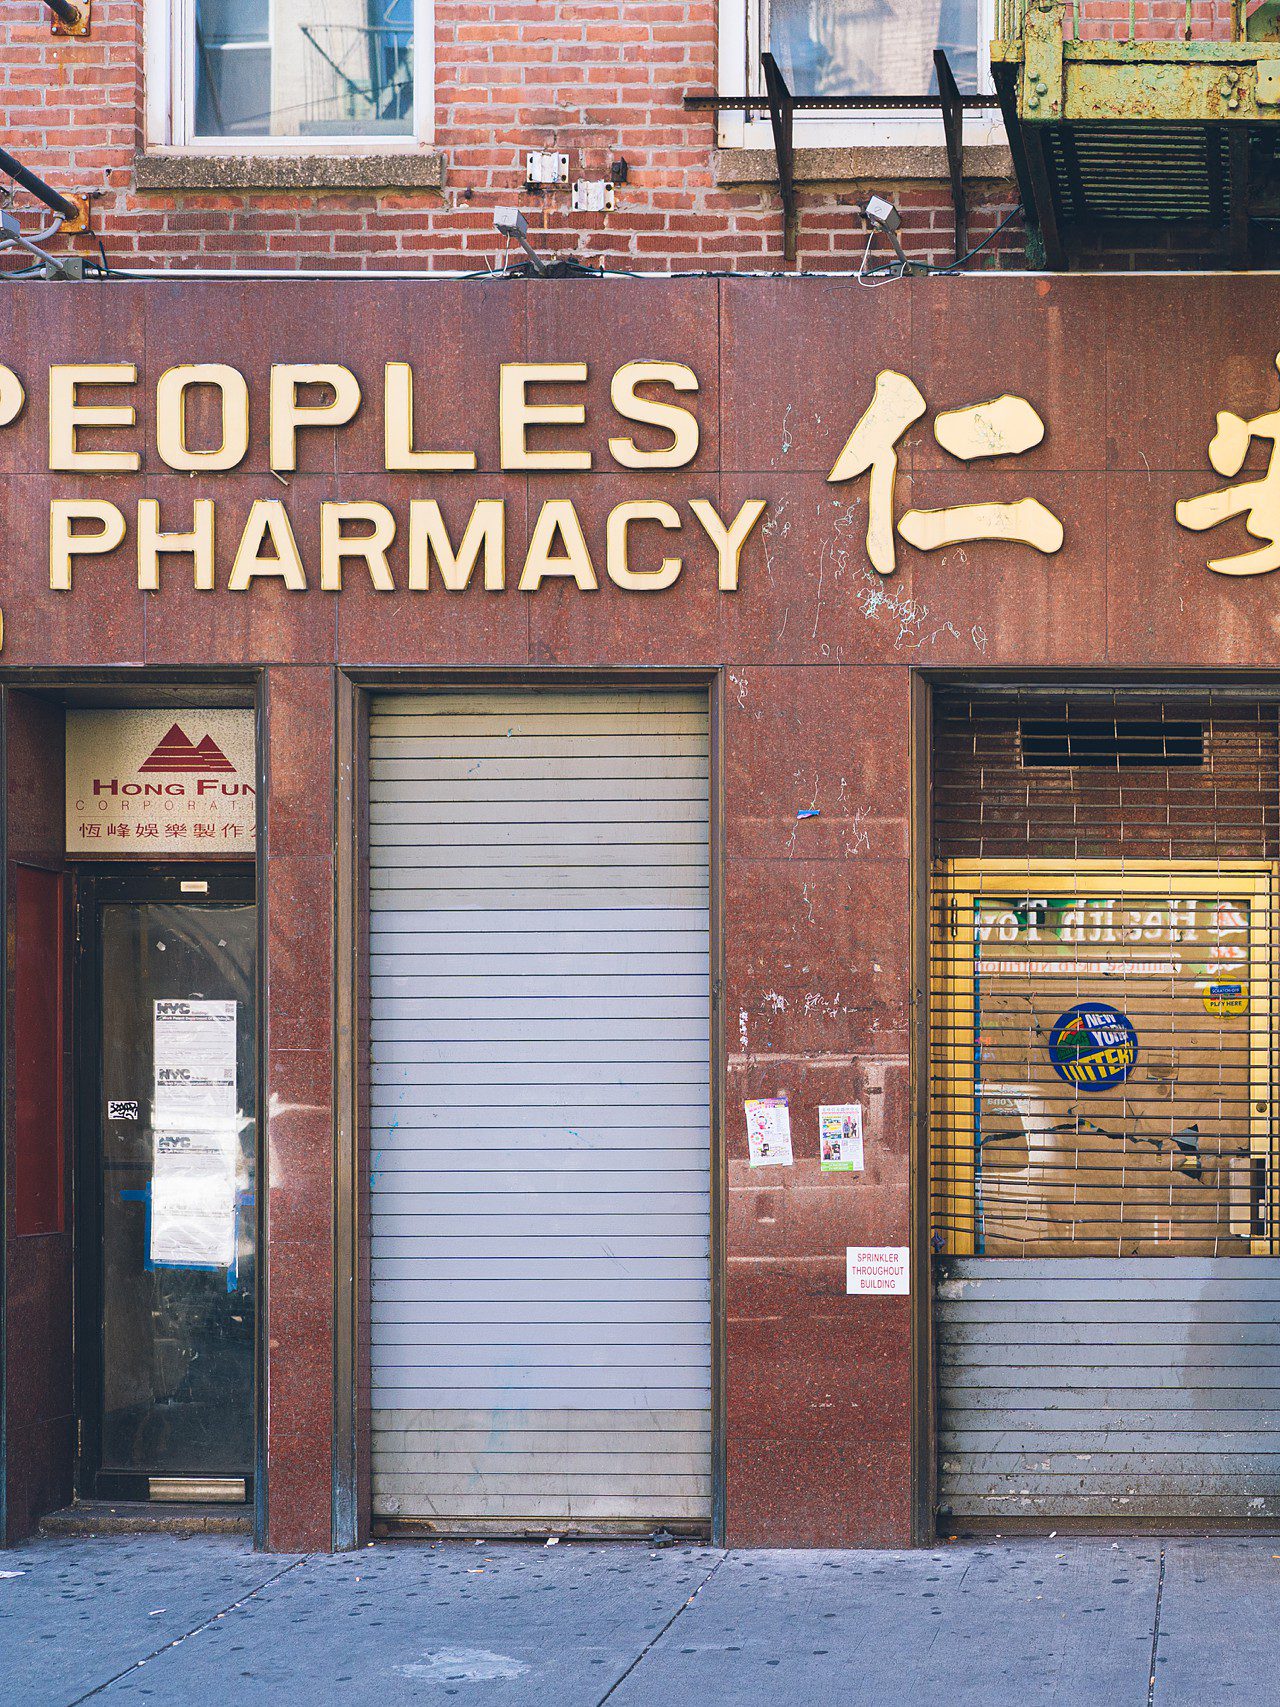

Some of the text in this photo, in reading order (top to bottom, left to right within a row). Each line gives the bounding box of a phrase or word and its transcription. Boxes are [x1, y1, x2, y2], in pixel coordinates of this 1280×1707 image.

[0, 361, 700, 472] EOPLES
[49, 499, 767, 591] PHARMACY
[79, 822, 256, 839] 恆峰娛樂製作
[157, 1002, 191, 1015] NYC
[1085, 1013, 1117, 1028] NEW
[1090, 1024, 1129, 1047] YORK
[857, 1253, 899, 1263] SPRINKLER
[852, 1266, 904, 1276] THROUGHOUT
[860, 1279, 896, 1289] BUILDING
